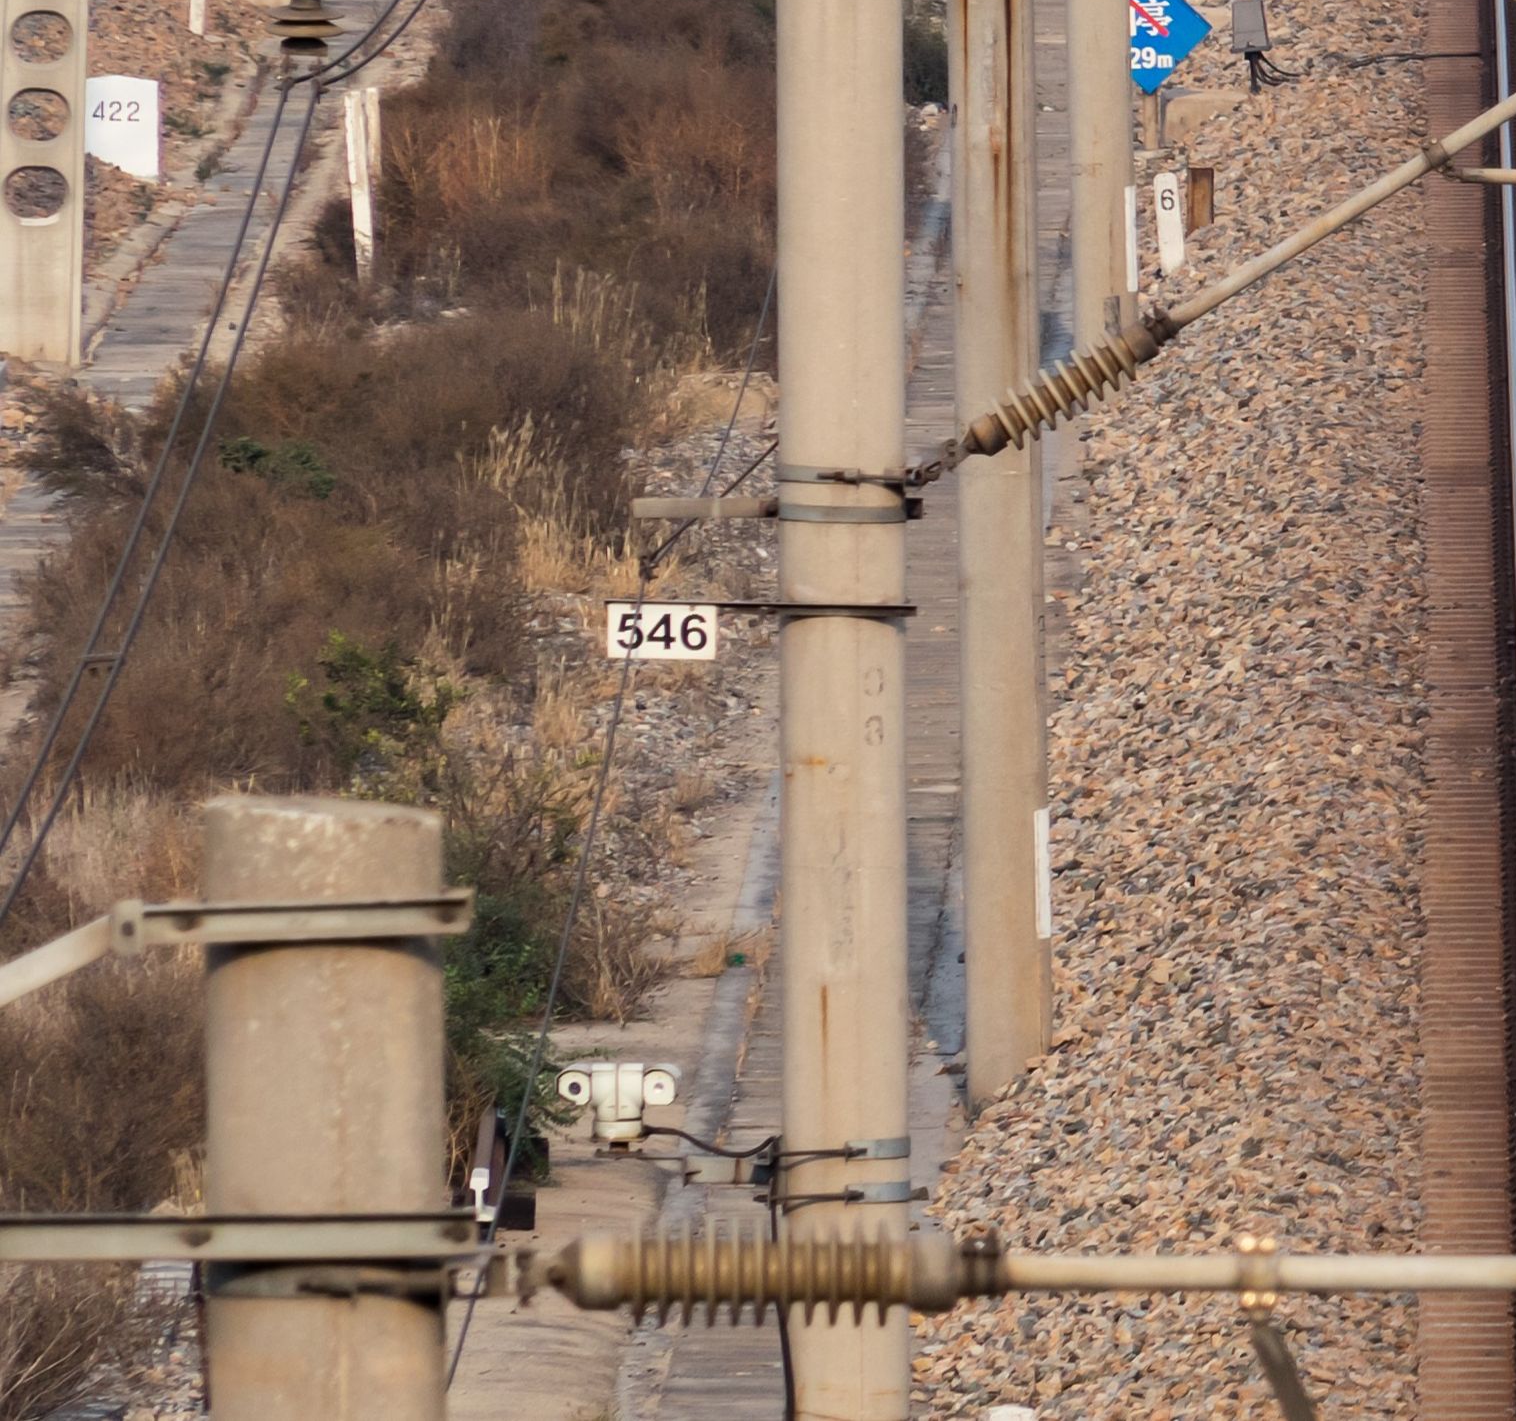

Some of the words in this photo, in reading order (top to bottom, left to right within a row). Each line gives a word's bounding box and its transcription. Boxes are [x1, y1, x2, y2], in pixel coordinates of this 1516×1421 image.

[92, 100, 140, 122] 422
[1160, 189, 1176, 211] 6
[617, 613, 708, 651] 546
